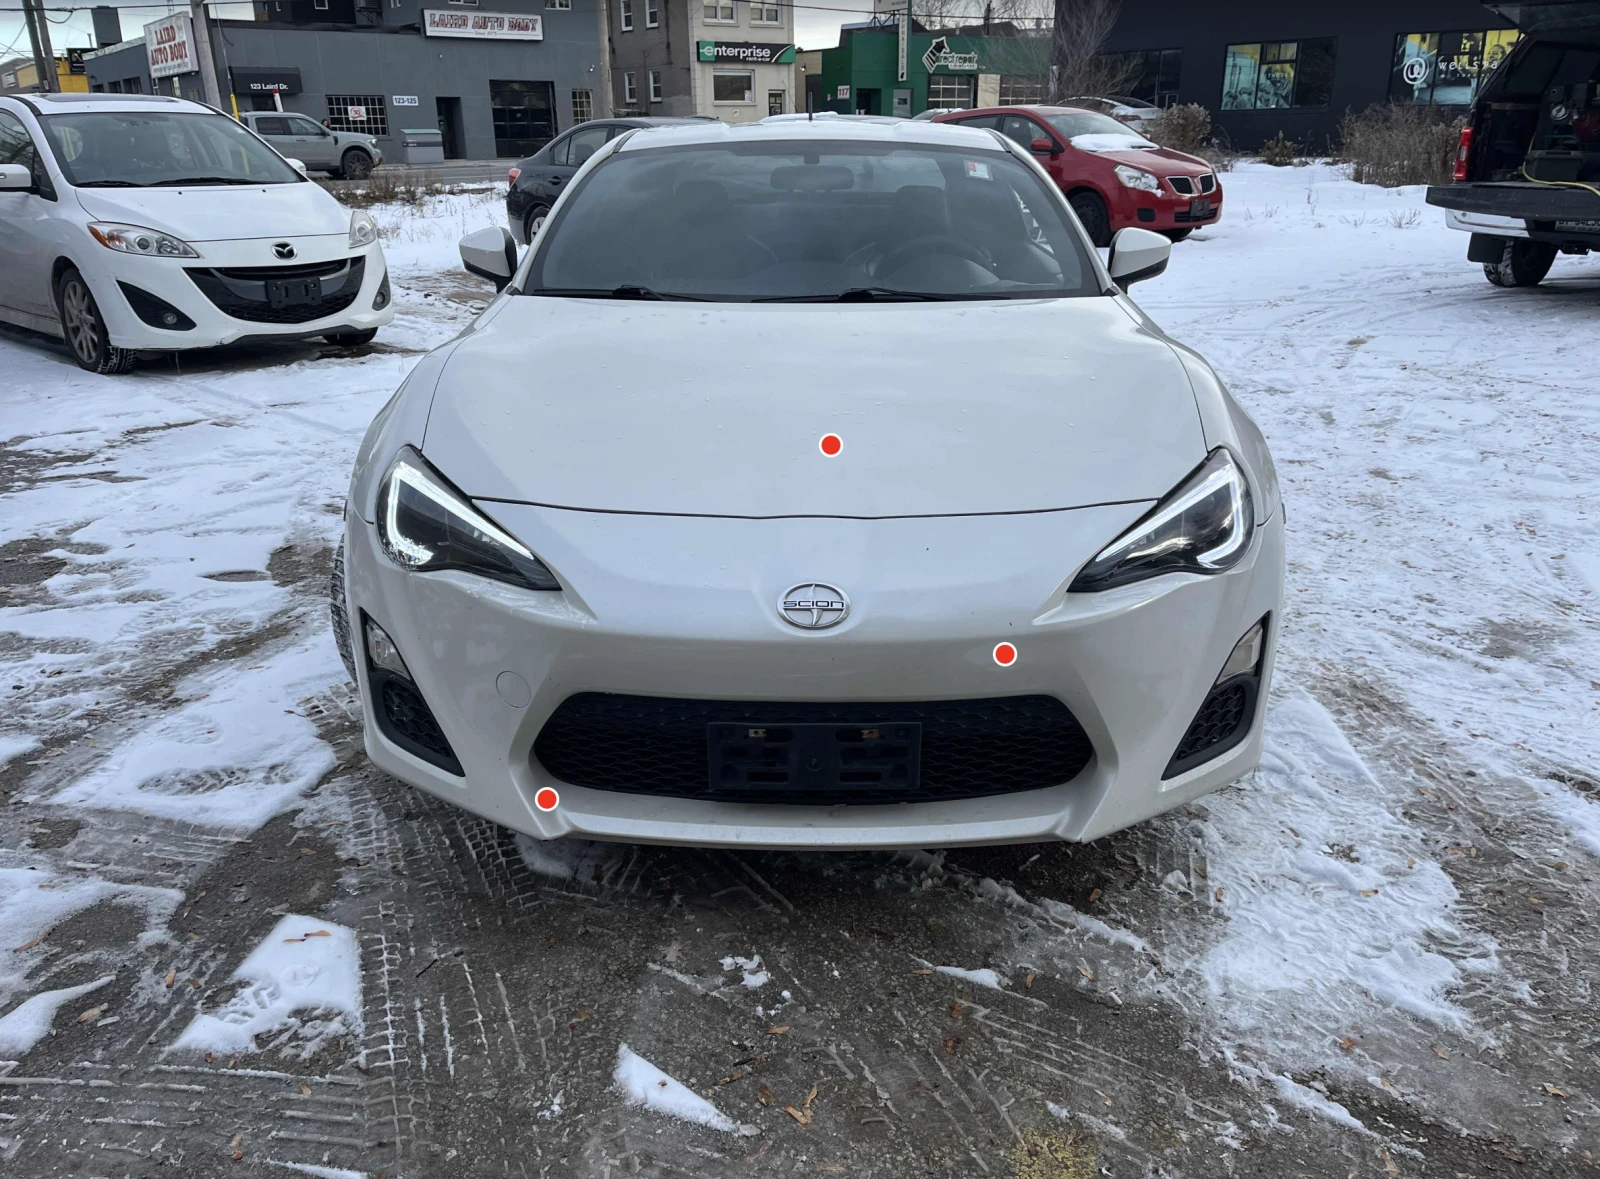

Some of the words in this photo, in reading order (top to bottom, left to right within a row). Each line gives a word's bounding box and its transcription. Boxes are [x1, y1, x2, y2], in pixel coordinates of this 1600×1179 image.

[430, 14, 468, 29] LAIRD
[472, 16, 504, 30] AUTO
[508, 18, 538, 31] BODY
[155, 25, 176, 45] LAIRD
[151, 46, 169, 66] AUTO
[168, 40, 188, 61] BODY
[702, 45, 771, 59] enterprise
[838, 88, 849, 96] 117
[783, 600, 844, 608] SCION
